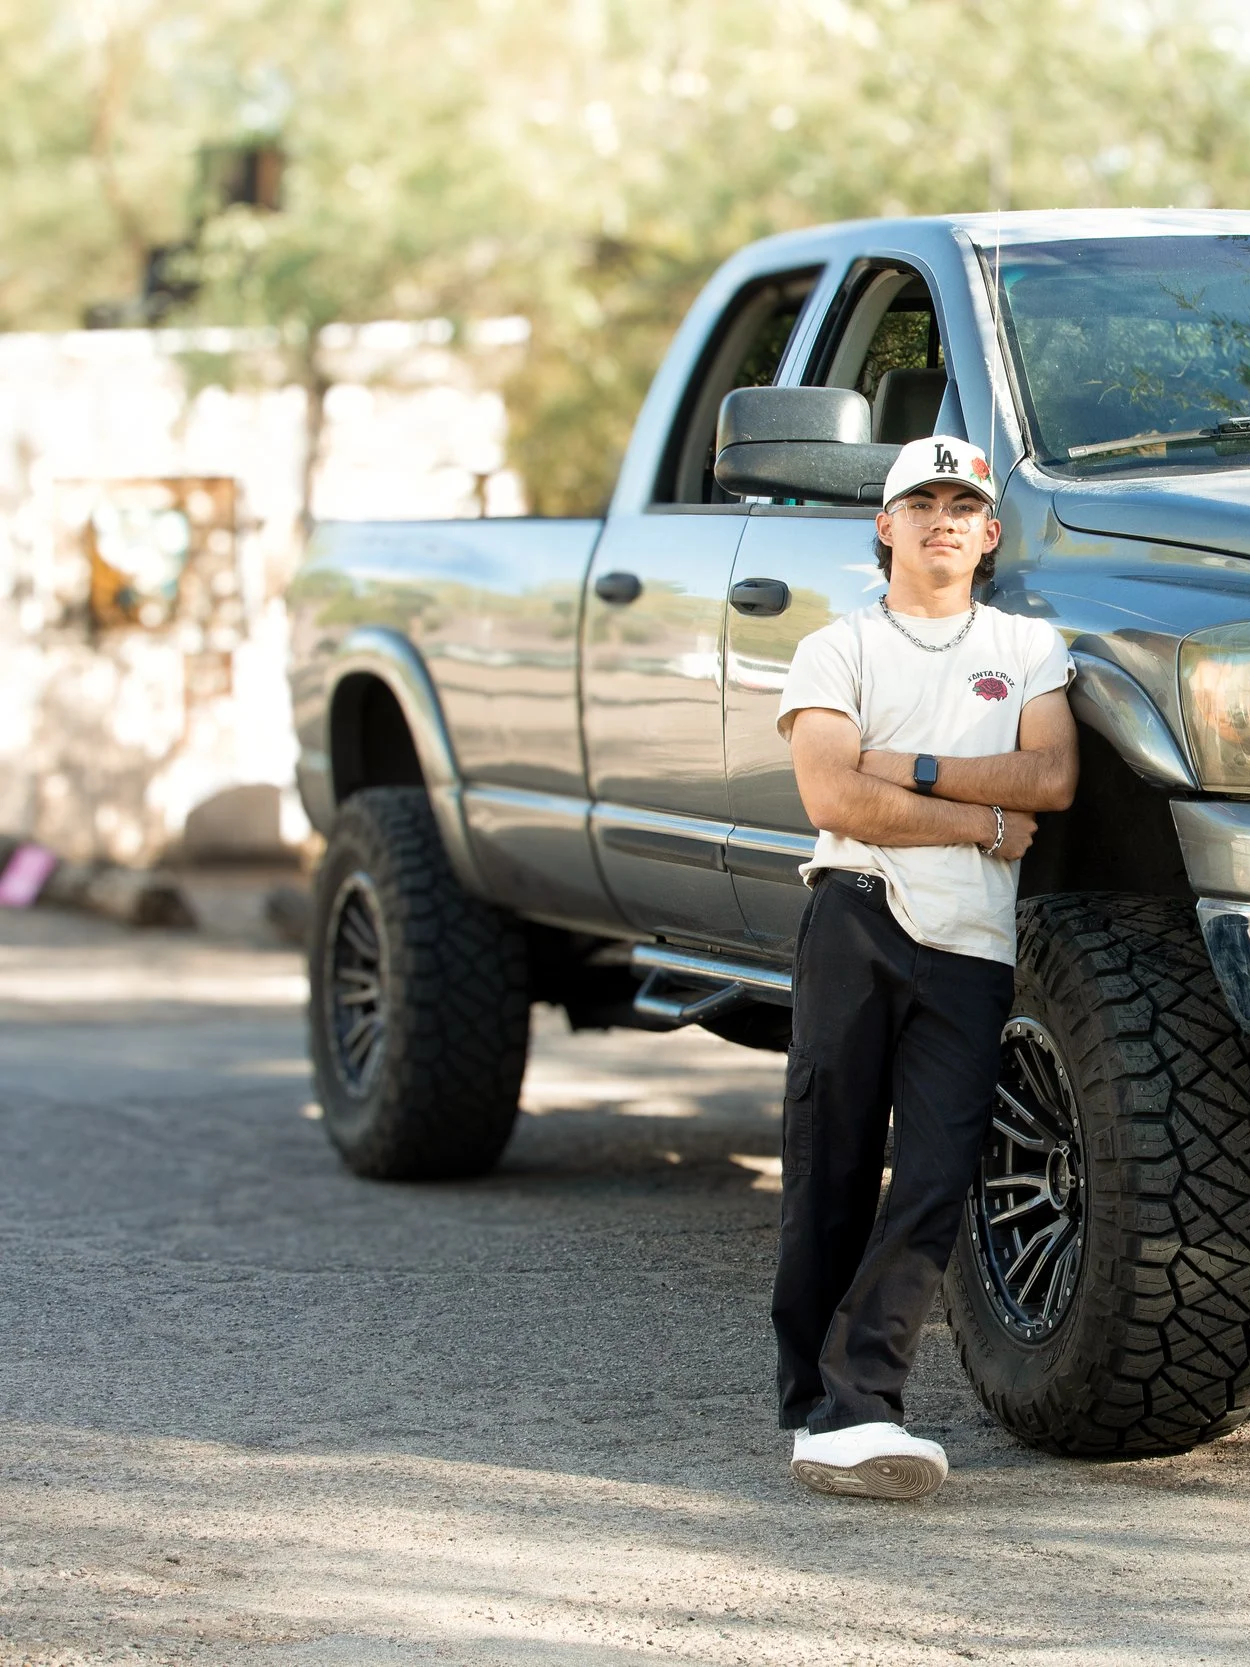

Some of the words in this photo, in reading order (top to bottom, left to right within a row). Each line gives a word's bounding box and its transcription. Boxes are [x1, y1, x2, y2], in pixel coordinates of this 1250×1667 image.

[934, 444, 958, 474] LA
[968, 670, 994, 684] SANTA
[995, 671, 1015, 688] CRUZ
